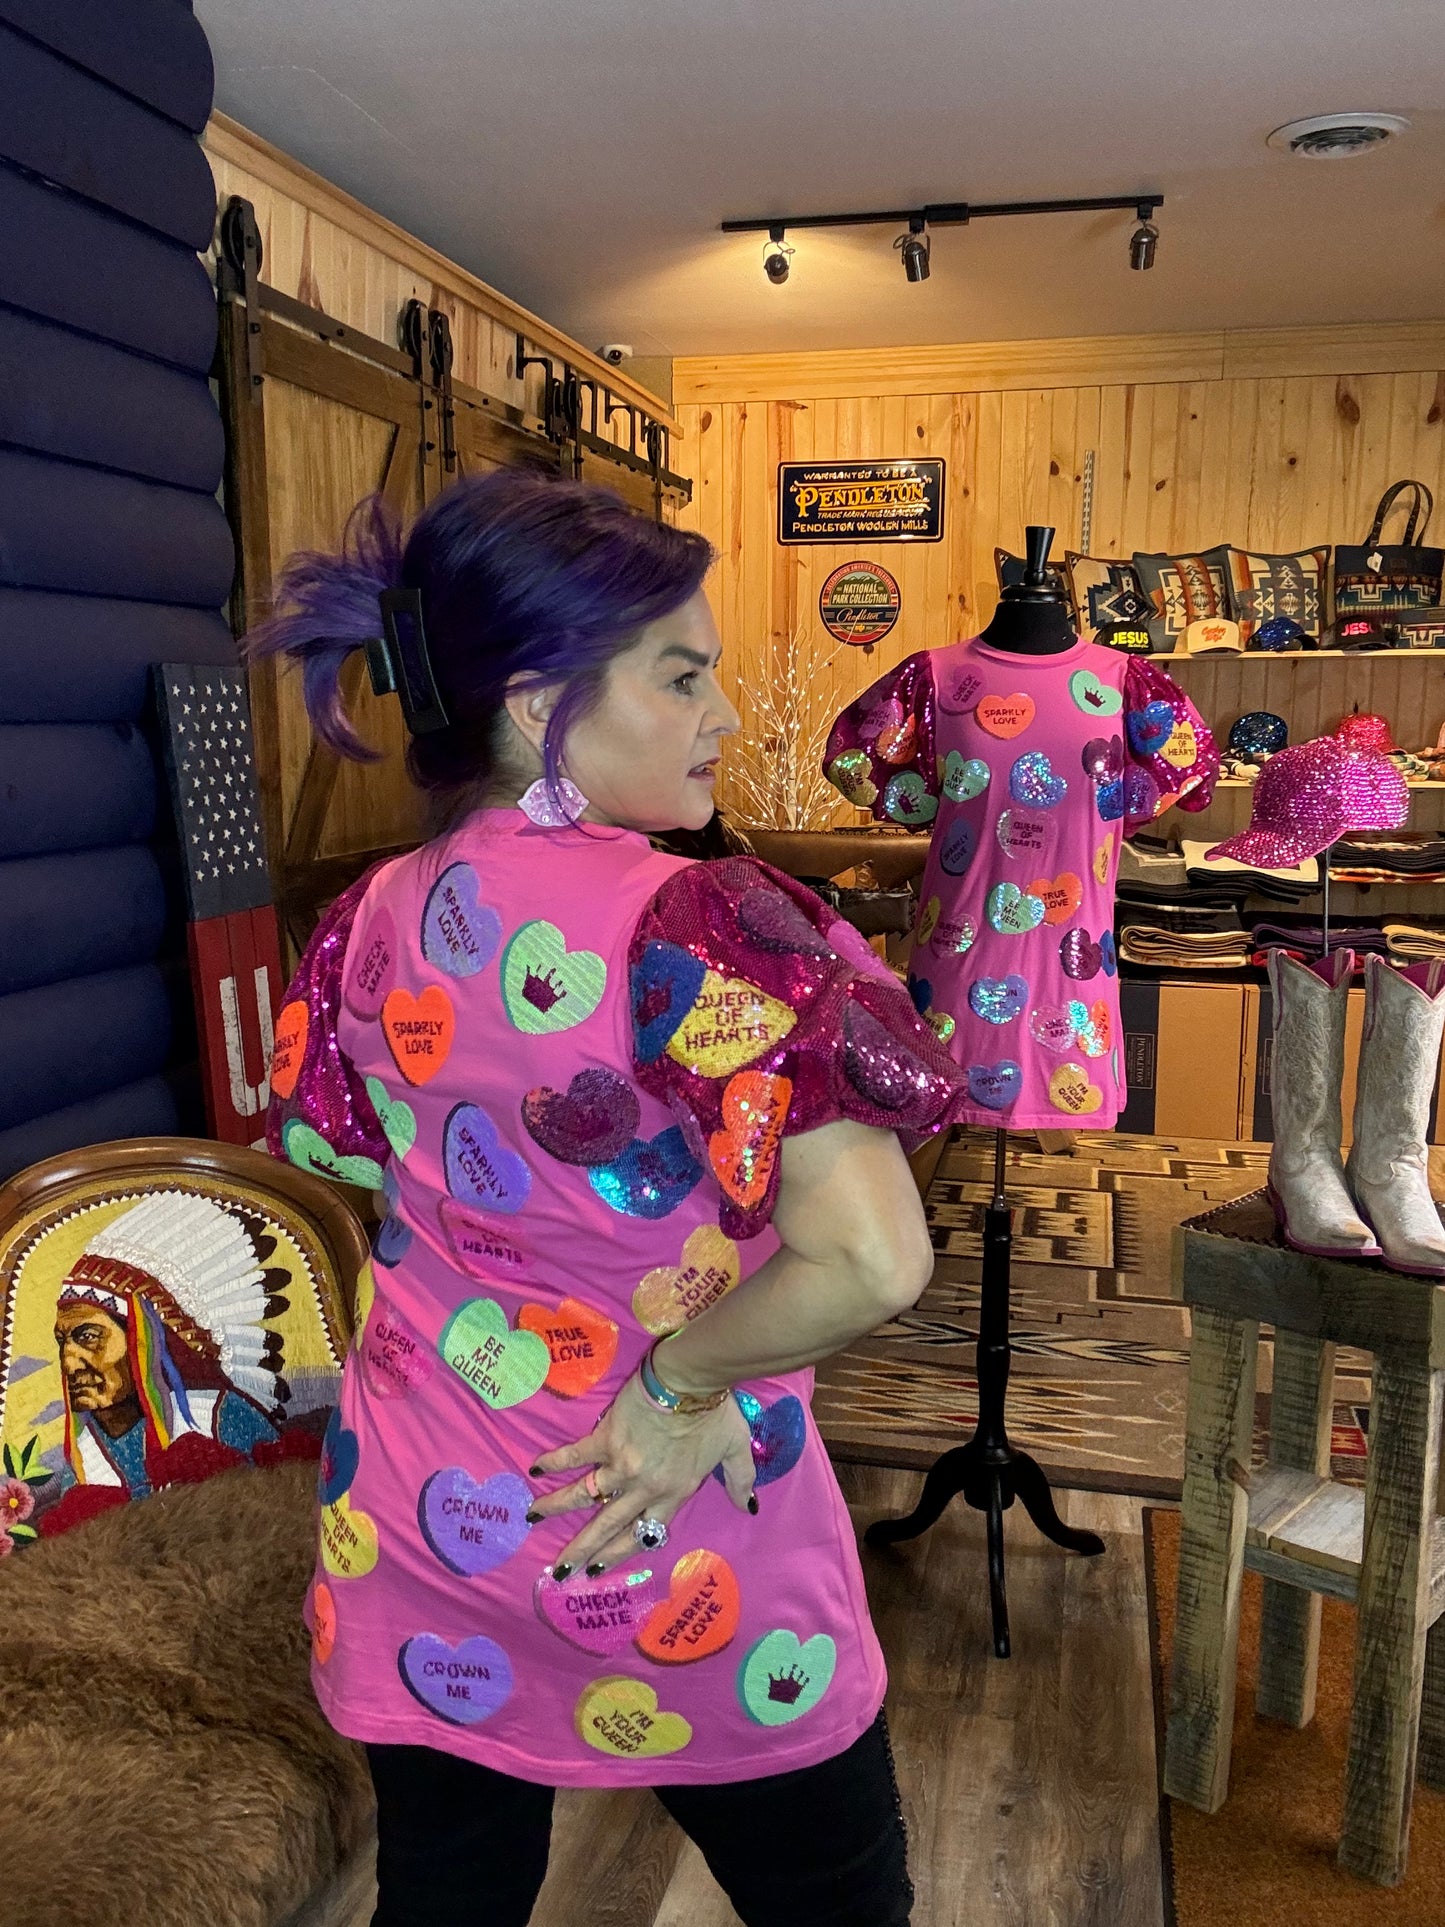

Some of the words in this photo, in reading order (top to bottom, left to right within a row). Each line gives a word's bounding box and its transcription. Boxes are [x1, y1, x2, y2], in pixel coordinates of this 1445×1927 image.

[803, 471, 872, 480] WARRANTED
[875, 469, 889, 478] TO
[892, 468, 906, 478] BE
[910, 467, 917, 477] A
[792, 522, 855, 532] PENDLETON
[857, 521, 899, 531] WOOLEN
[901, 520, 928, 530] MILLS
[843, 583, 878, 594] NATIONAL
[832, 594, 848, 604] PARK
[849, 594, 888, 604] COLLECTION
[1109, 631, 1149, 646] JESUS
[1341, 622, 1374, 636] JES
[953, 673, 975, 701] CHECK
[961, 679, 981, 703] MATE
[984, 708, 1026, 718] SPARKLY
[993, 717, 1017, 725] LOVE
[1178, 740, 1187, 748] OF
[951, 774, 963, 785] MY
[954, 767, 964, 778] BE
[1013, 822, 1043, 833] QUEEN
[1020, 831, 1033, 839] OF
[1006, 838, 1041, 849] HEARTS
[950, 846, 968, 864] LOVE
[1042, 889, 1067, 900] TRUE
[1045, 898, 1069, 909] LOVE
[1003, 906, 1017, 917] MY
[1008, 900, 1020, 910] BE
[443, 886, 479, 955] SPARKLY
[999, 912, 1021, 929] UEEN
[438, 909, 460, 955] LOVE
[357, 933, 385, 990] CHECK
[367, 950, 390, 996] MATE
[694, 991, 765, 1010] QUEEN
[715, 1008, 743, 1027] OF
[392, 1021, 443, 1039] SPARKLY
[686, 1023, 770, 1052] HEARTS
[405, 1039, 434, 1055] LOVE
[1136, 1037, 1146, 1083] PENDLETON
[1058, 1087, 1081, 1110] QUEEN
[1067, 1083, 1085, 1105] YOUR
[1076, 1082, 1088, 1095] I'M
[457, 1150, 486, 1196] LOVE
[458, 1127, 508, 1199] SPARKLY
[463, 1239, 523, 1264] HEARTS
[674, 1266, 700, 1292] I'M
[676, 1266, 721, 1308] YOUR
[685, 1269, 732, 1321] QUEEN
[376, 1324, 415, 1354] QUEEN
[545, 1327, 589, 1344] TRUE
[484, 1335, 505, 1358] BE
[550, 1343, 595, 1364] LOVE
[471, 1347, 497, 1371] MY
[452, 1354, 501, 1399] QUEEN
[442, 1497, 509, 1524] CROWN
[331, 1501, 358, 1548] QUEEN
[333, 1524, 345, 1544] OF
[460, 1525, 484, 1544] ME
[565, 1591, 632, 1613] CHECK
[659, 1575, 718, 1649] SPARKLY
[576, 1609, 632, 1630] MATE
[684, 1602, 722, 1645] LOVE
[423, 1661, 490, 1680] CROWN
[446, 1683, 471, 1700] ME
[610, 1709, 647, 1745] YOUR
[629, 1710, 654, 1731] I'M
[593, 1716, 640, 1752] QUEEN
